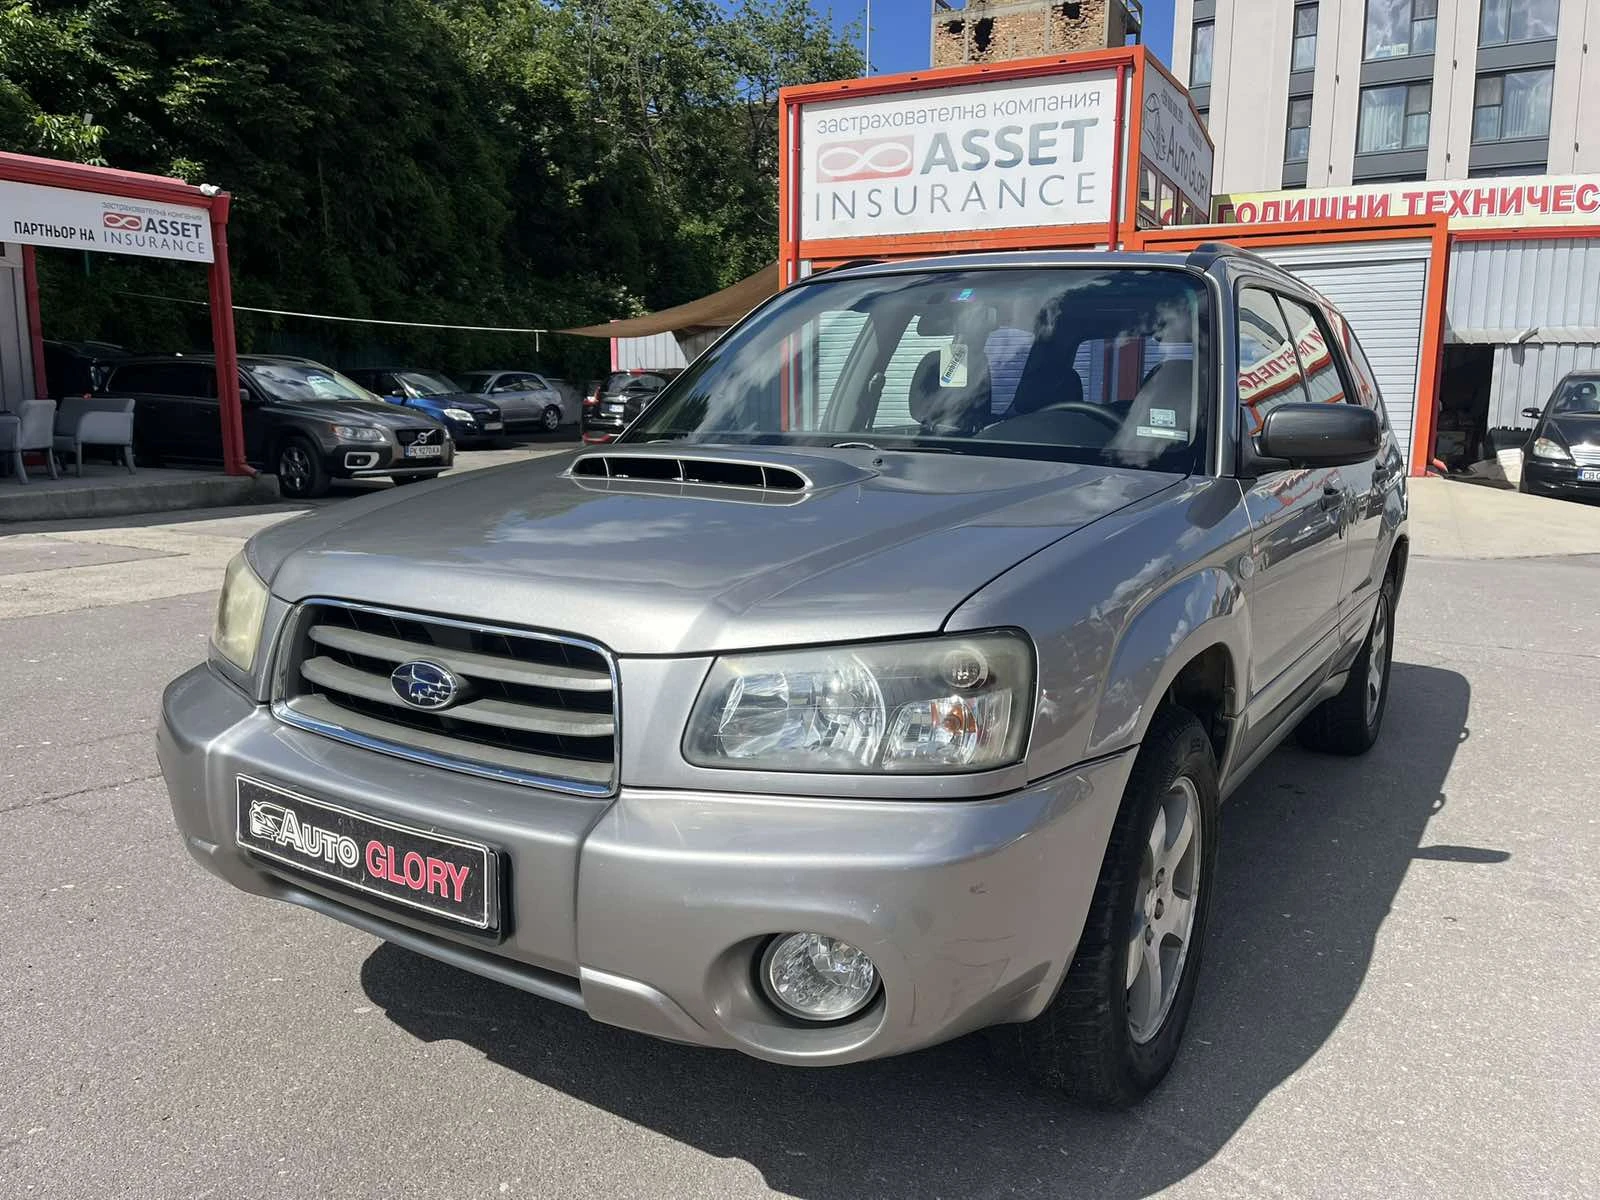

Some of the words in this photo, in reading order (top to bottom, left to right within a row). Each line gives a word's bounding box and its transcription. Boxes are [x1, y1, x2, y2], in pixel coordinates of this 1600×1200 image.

[816, 104, 987, 135] застрахователна
[994, 91, 1101, 119] компания
[920, 118, 1099, 175] ASSET
[815, 172, 1096, 221] INSURANCE
[1217, 193, 1391, 224] ГОДИШНИ
[1402, 183, 1600, 217] ТЕХНИЧЕС
[14, 221, 76, 240] ПАРТНЬОР
[80, 226, 95, 242] НА
[103, 231, 205, 255] INSURANCE
[145, 217, 202, 239] ASSET
[276, 809, 359, 868] AUTO
[366, 840, 469, 903] GLORY
